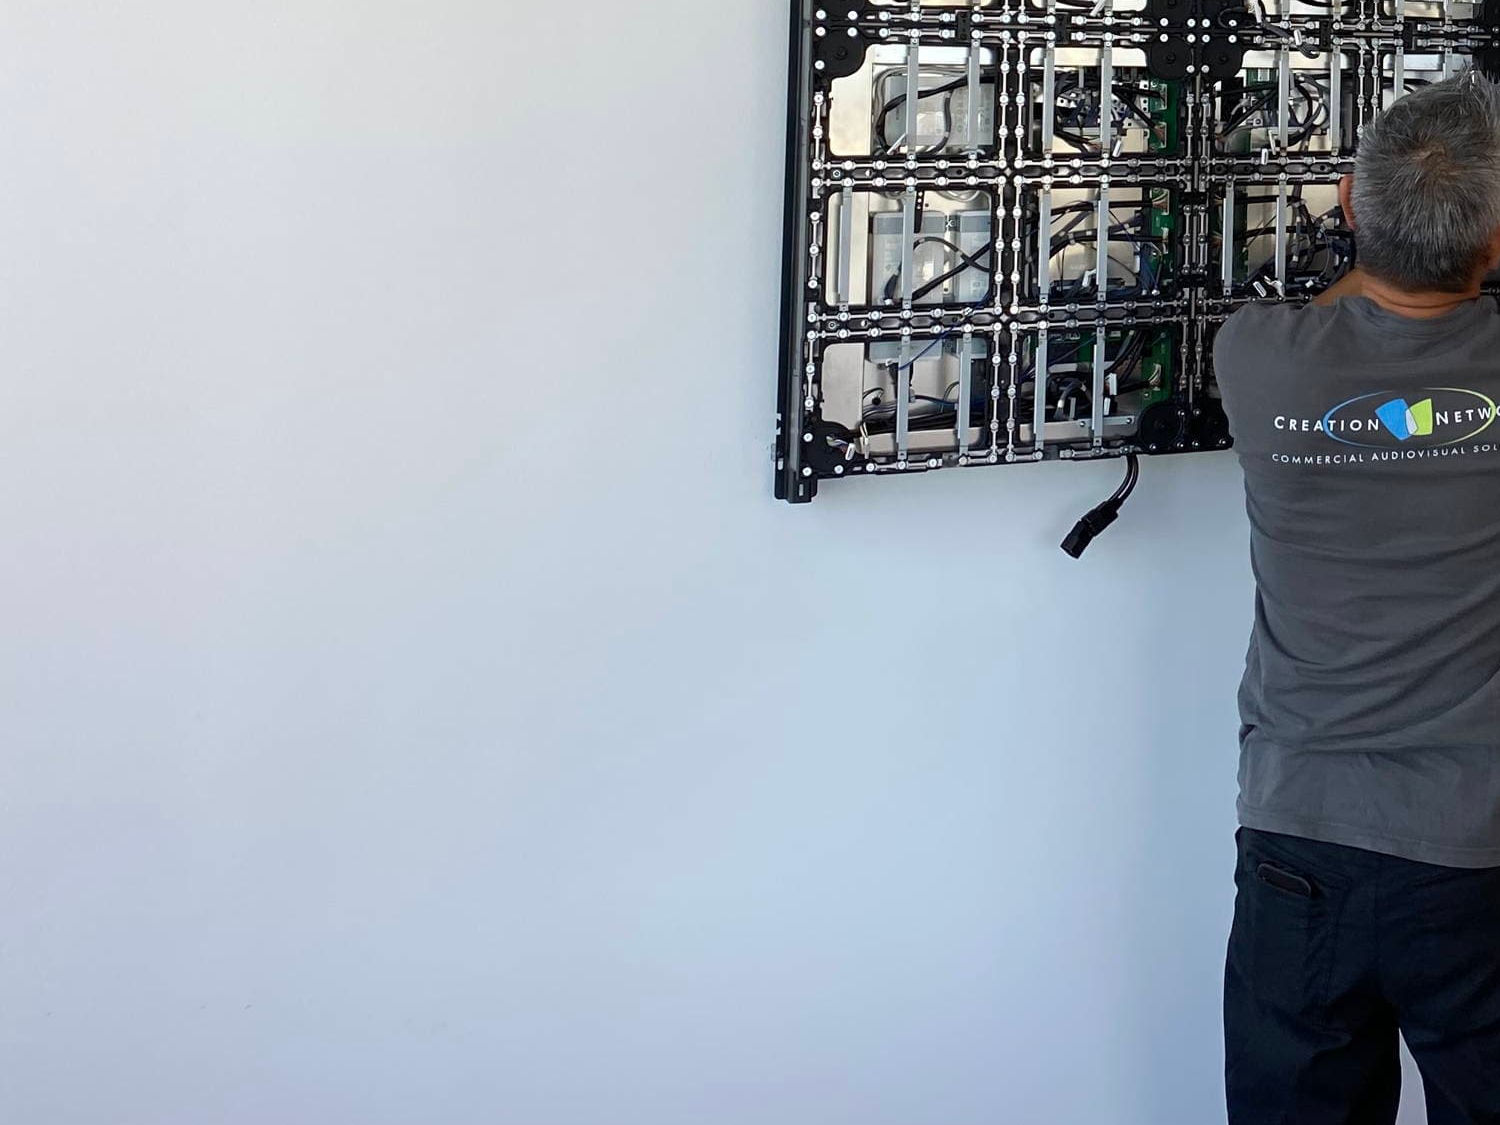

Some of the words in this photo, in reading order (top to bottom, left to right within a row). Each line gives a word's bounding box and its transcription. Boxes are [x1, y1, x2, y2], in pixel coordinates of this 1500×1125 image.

[1273, 415, 1380, 432] CREATION
[1271, 453, 1365, 465] COMMERCIAL
[1371, 446, 1465, 461] AUDIOVISUAL
